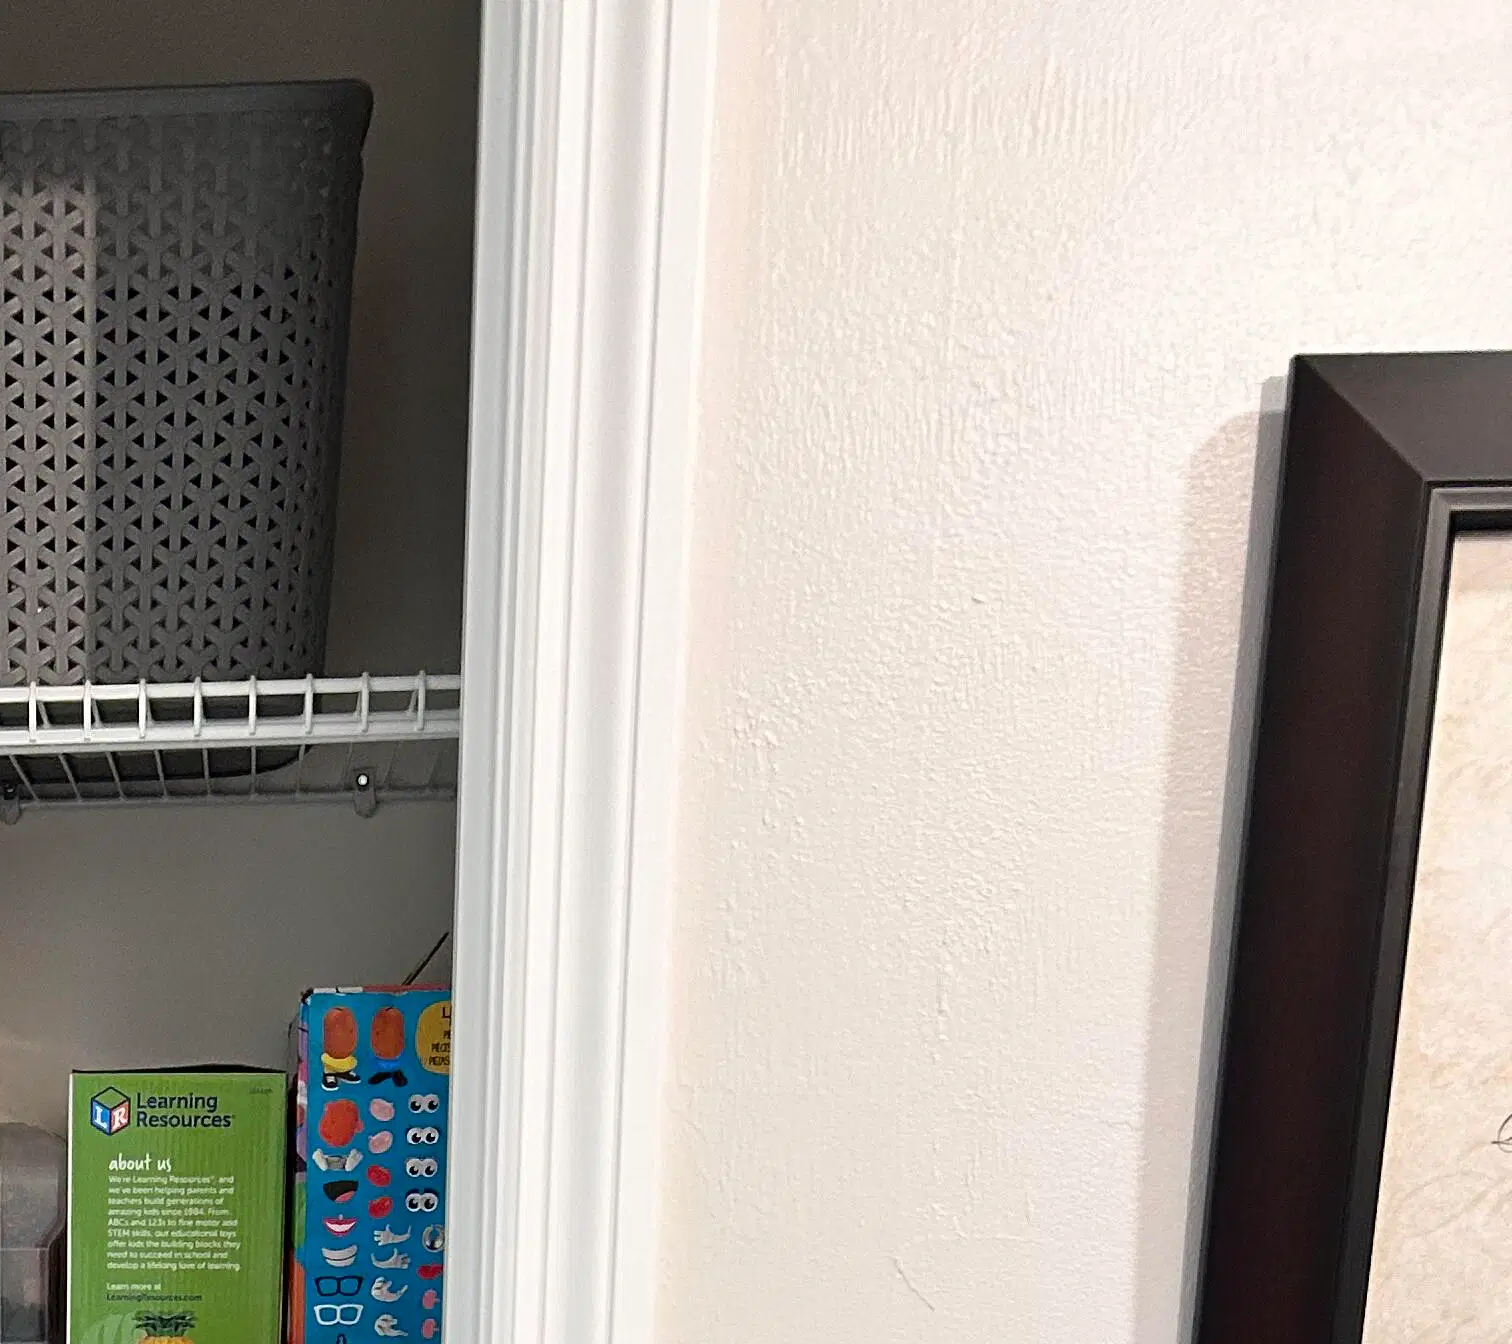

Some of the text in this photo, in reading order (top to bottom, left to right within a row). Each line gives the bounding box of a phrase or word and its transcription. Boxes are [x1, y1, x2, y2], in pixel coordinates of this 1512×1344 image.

[137, 1092, 218, 1112] Learning
[94, 1106, 128, 1130] L R
[137, 1112, 232, 1128] Resources
[108, 1153, 172, 1172] about us
[133, 1176, 168, 1185] Learning
[108, 1229, 129, 1237] STEM
